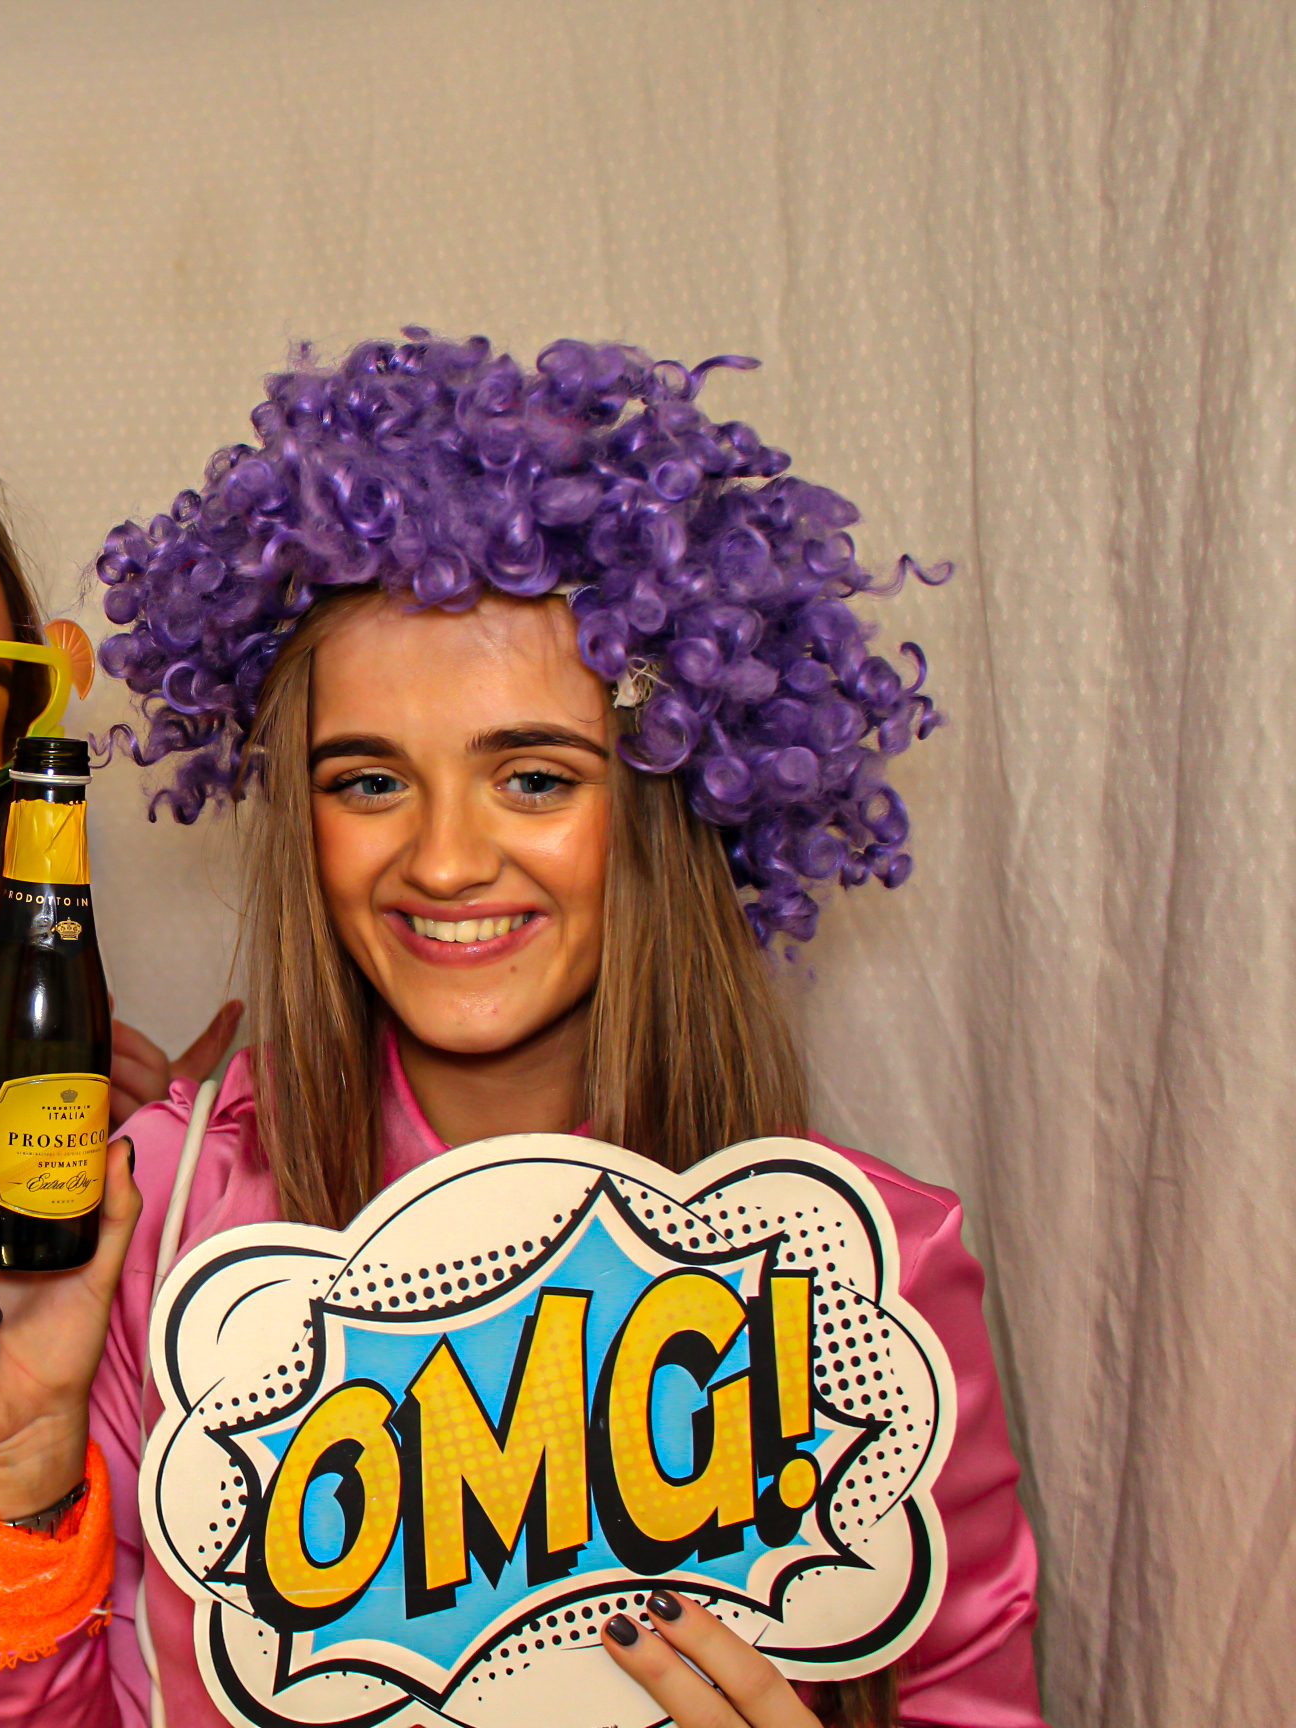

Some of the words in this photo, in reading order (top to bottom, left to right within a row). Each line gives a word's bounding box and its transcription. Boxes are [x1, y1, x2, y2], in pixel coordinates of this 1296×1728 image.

[76, 898, 89, 906] IN
[49, 1112, 85, 1120] ITALIA
[8, 1129, 105, 1148] PROSECCO
[38, 1160, 88, 1168] SPUMANTE
[27, 1173, 65, 1192] Extra
[65, 1170, 92, 1195] Dry
[252, 1266, 823, 1628] OMG!
